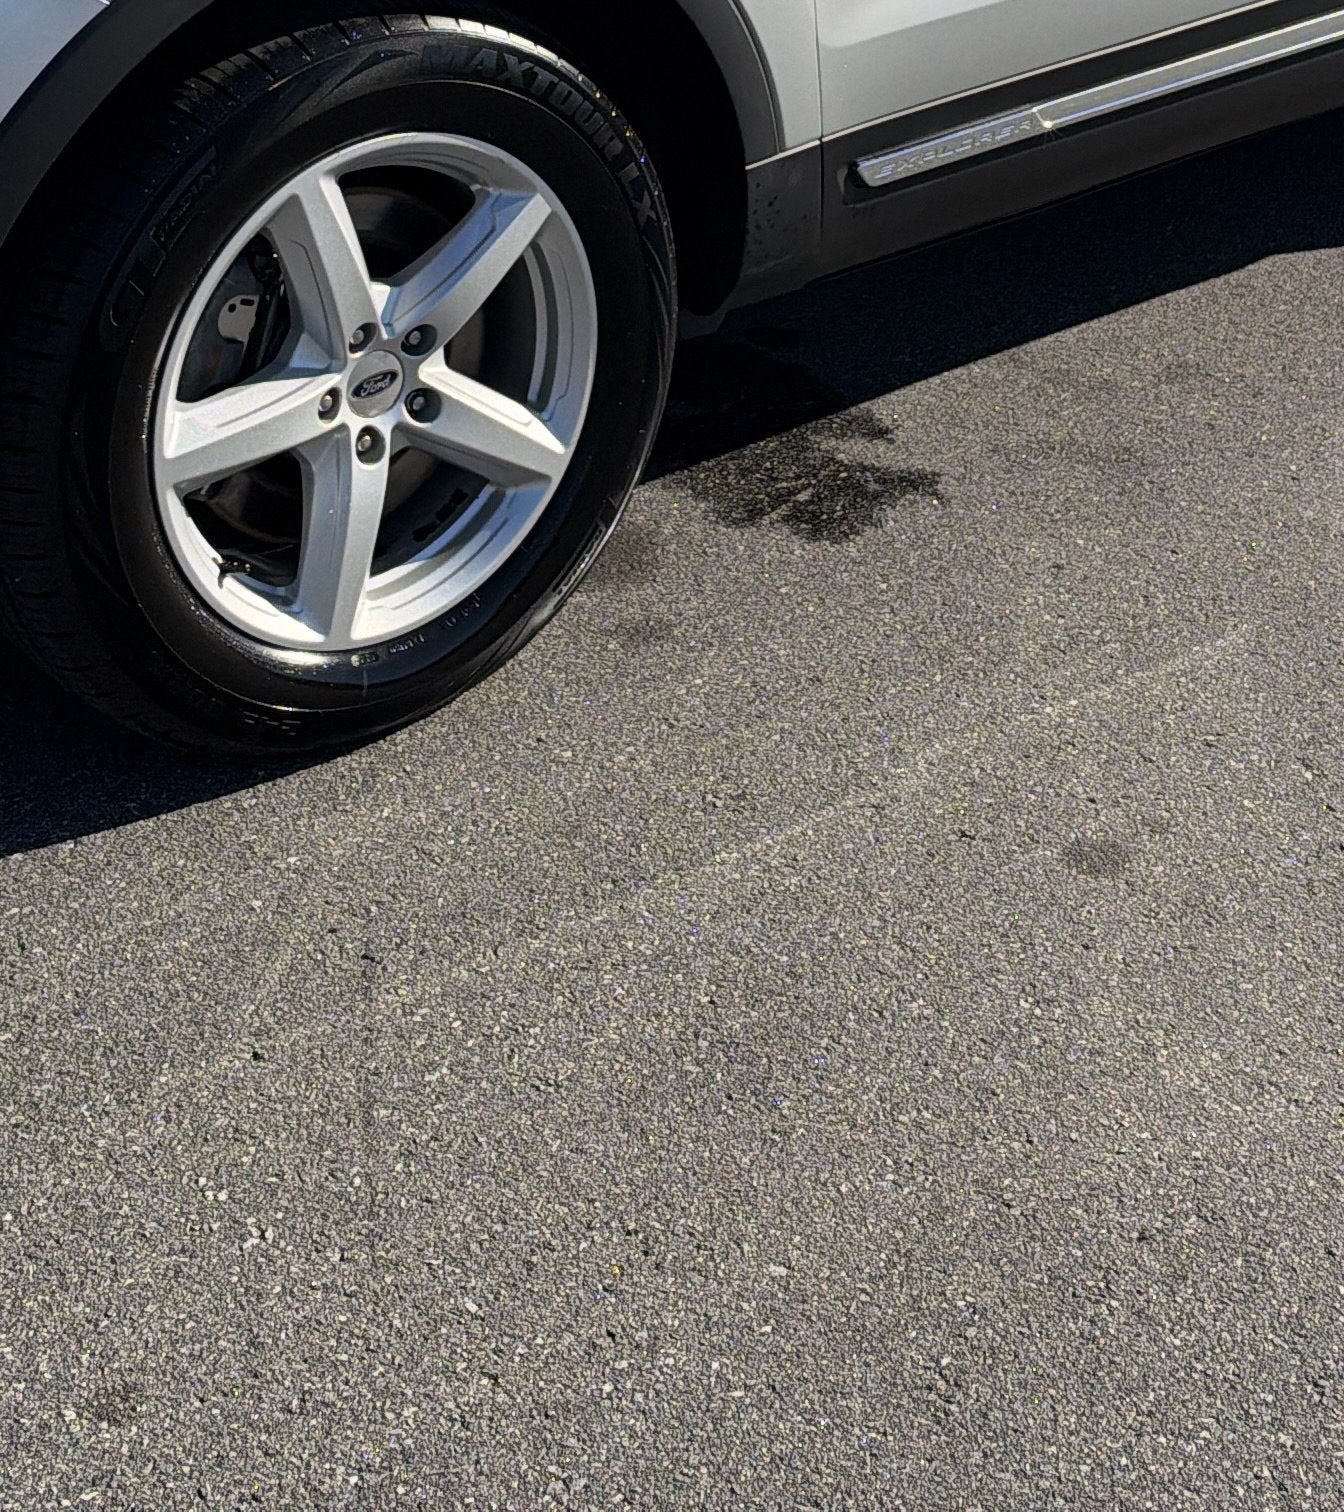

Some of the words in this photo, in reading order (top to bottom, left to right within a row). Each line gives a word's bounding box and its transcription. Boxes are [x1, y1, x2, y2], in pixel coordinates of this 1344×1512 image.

[419, 45, 624, 161] MAXTOUR
[617, 162, 657, 227] LX
[360, 373, 392, 397] Ford
